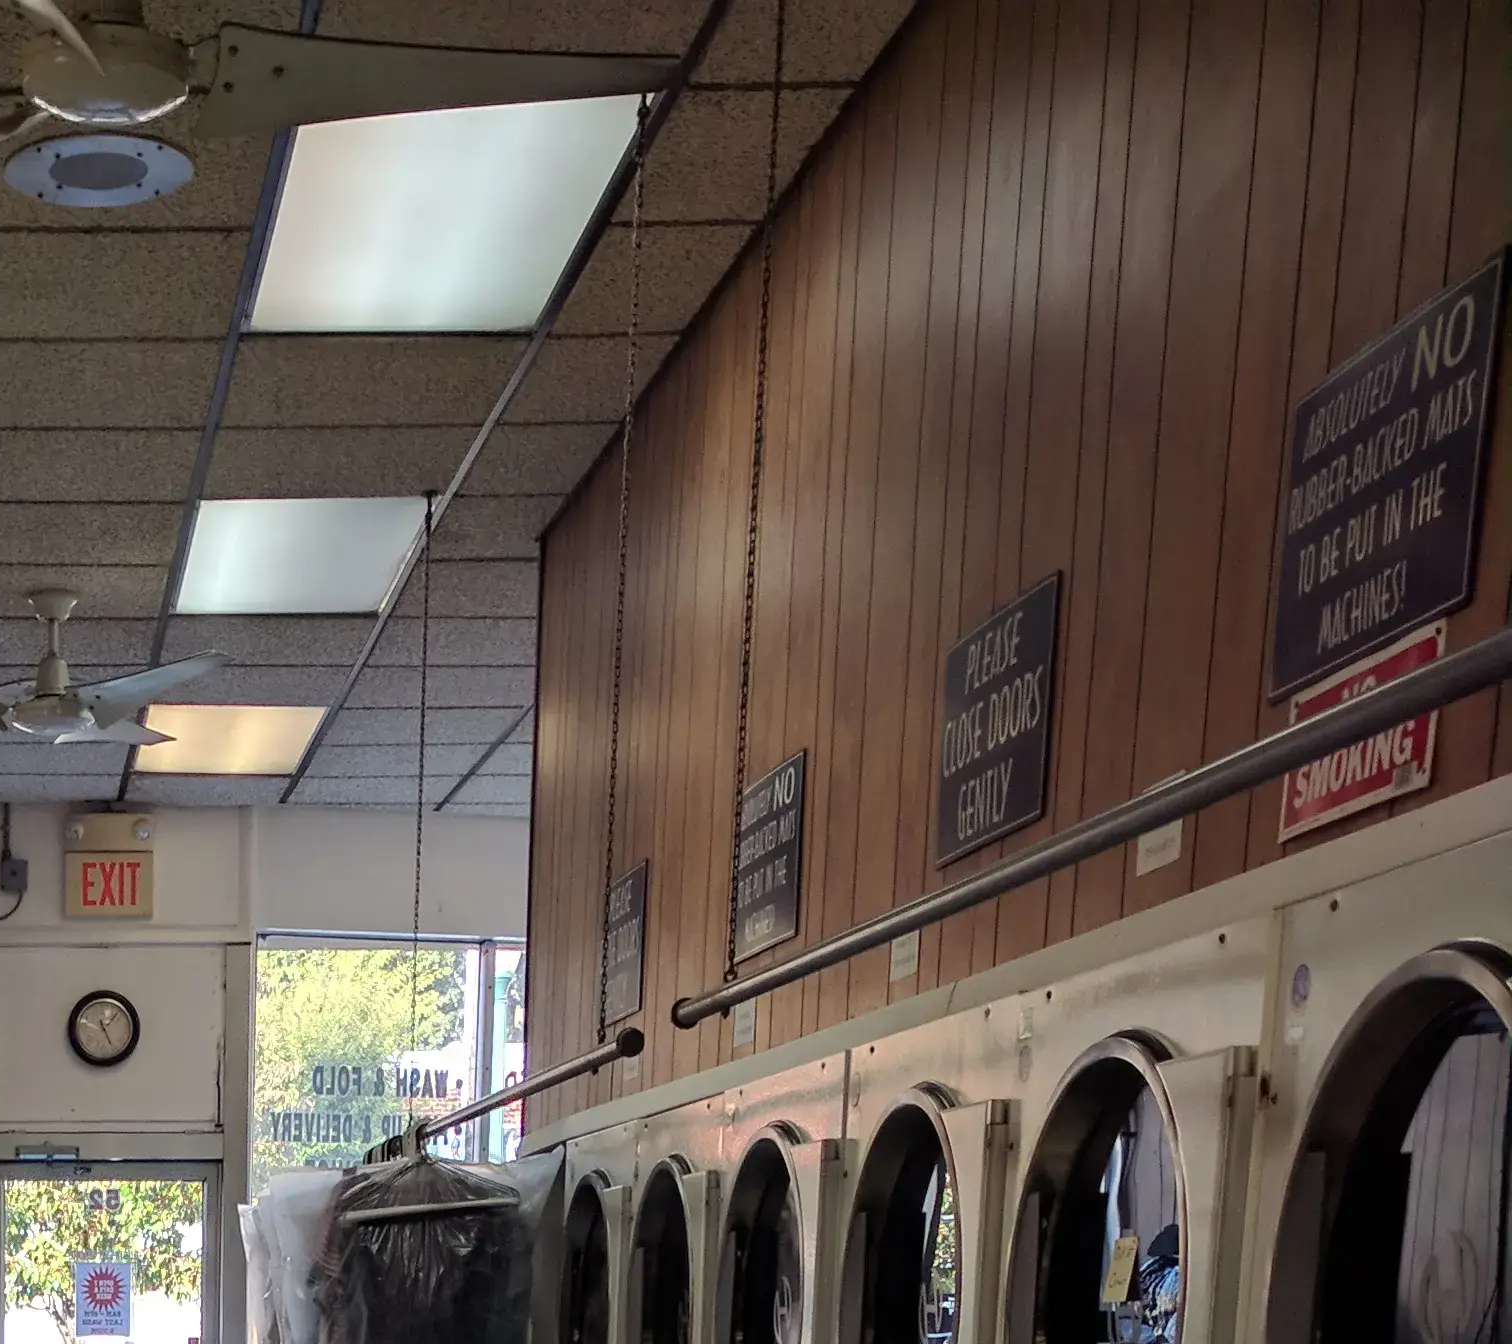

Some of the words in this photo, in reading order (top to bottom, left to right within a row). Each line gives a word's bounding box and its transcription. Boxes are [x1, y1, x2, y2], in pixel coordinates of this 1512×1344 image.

[1302, 345, 1408, 464] ABSOLUTELY
[1411, 294, 1476, 391] NO
[1288, 407, 1419, 536] RUBBER-BACKED
[1422, 362, 1478, 452] MATS
[1296, 542, 1316, 599] TO
[1318, 528, 1340, 580] BE
[1344, 504, 1378, 566] PUT
[1381, 485, 1405, 542] IN
[1409, 461, 1448, 532] THE
[965, 611, 1023, 695] PLEASE
[1317, 559, 1408, 657] MACHINES!
[943, 701, 984, 778] CLOSE
[987, 664, 1044, 751] DOORS
[1293, 723, 1415, 808] SMOKING
[773, 767, 796, 812] NO
[957, 757, 1013, 840] GENTLY
[82, 862, 141, 907] EXIT
